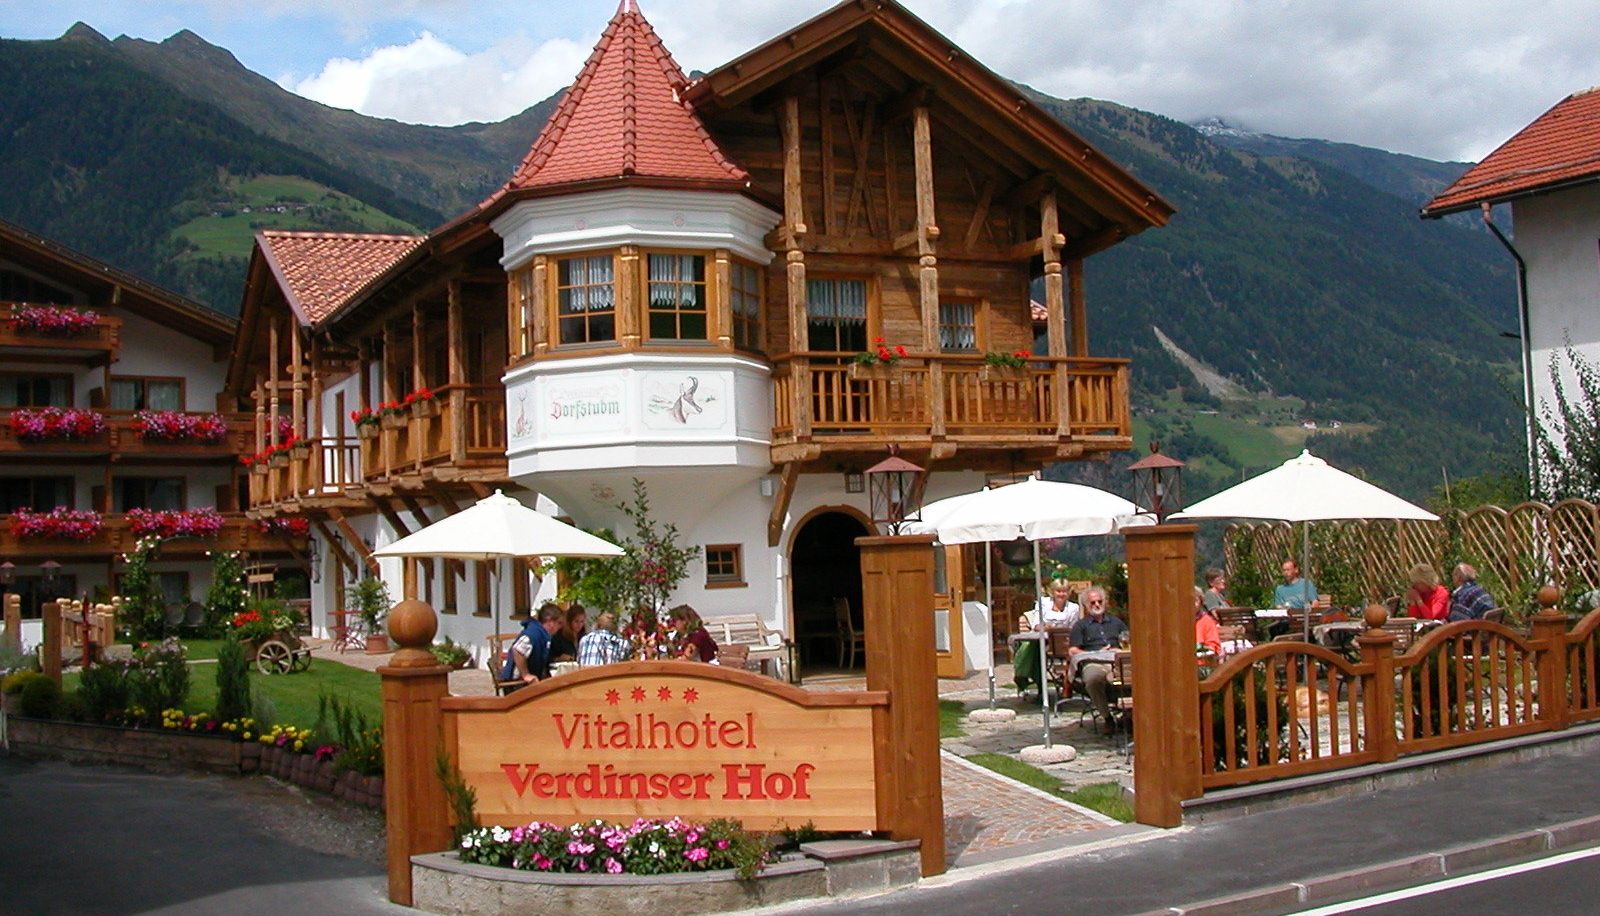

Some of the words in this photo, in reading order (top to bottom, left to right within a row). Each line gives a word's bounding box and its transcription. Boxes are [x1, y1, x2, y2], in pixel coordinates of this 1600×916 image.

[551, 712, 757, 750] Vitalhotel
[500, 763, 715, 801] Verdinser
[720, 763, 817, 801] Hof
